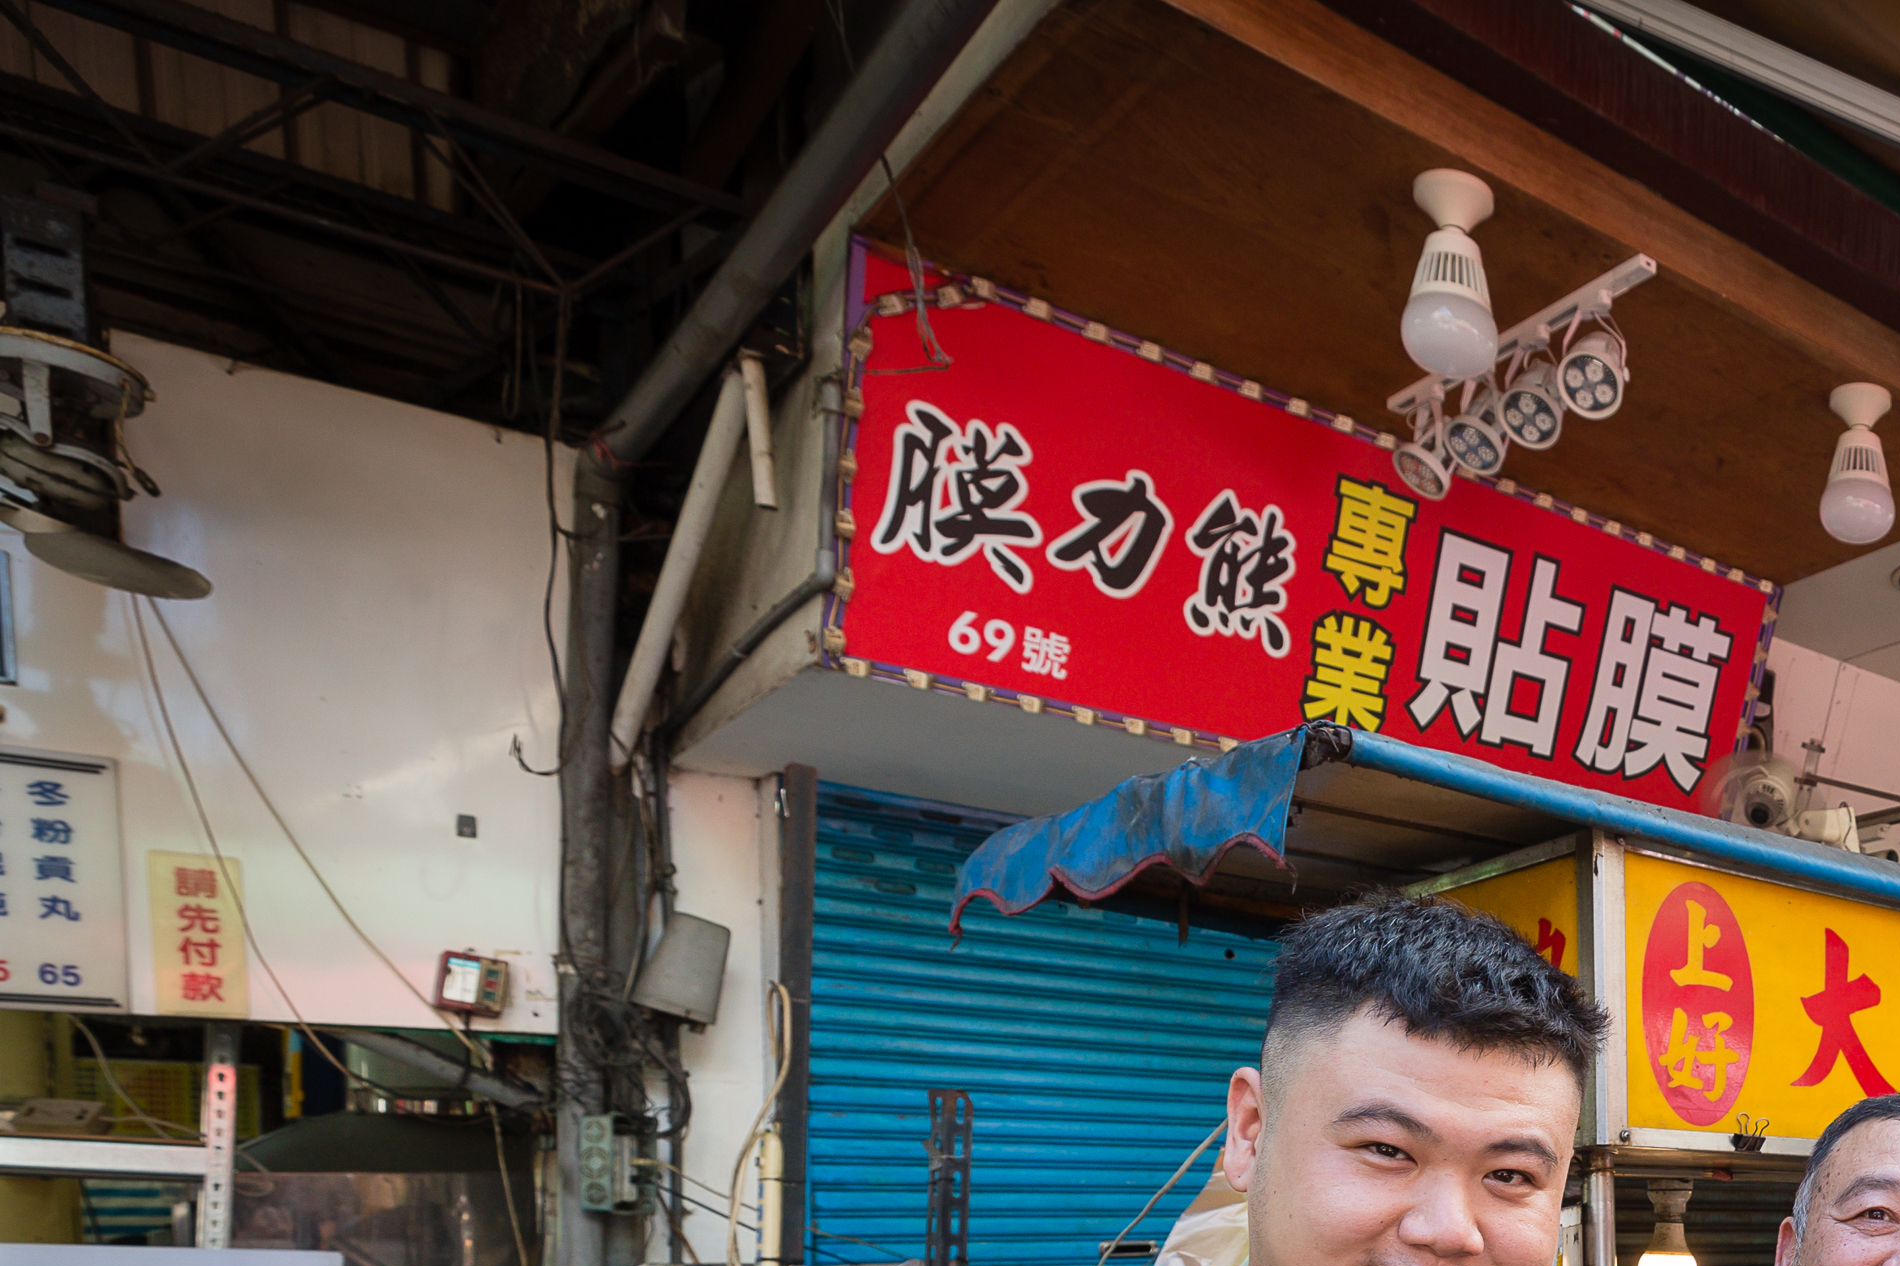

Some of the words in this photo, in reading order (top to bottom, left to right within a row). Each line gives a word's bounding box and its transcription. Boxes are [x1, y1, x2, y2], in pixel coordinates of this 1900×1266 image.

[872, 399, 1297, 657] 膜力熊
[1301, 474, 1419, 734] 專業
[947, 609, 1069, 681] 69號
[1409, 527, 1733, 794] 貼膜
[26, 781, 80, 922] 冬粉貢丸
[174, 866, 225, 1002] 請先付款
[38, 963, 82, 986] 65
[1658, 898, 1740, 1103] 上好
